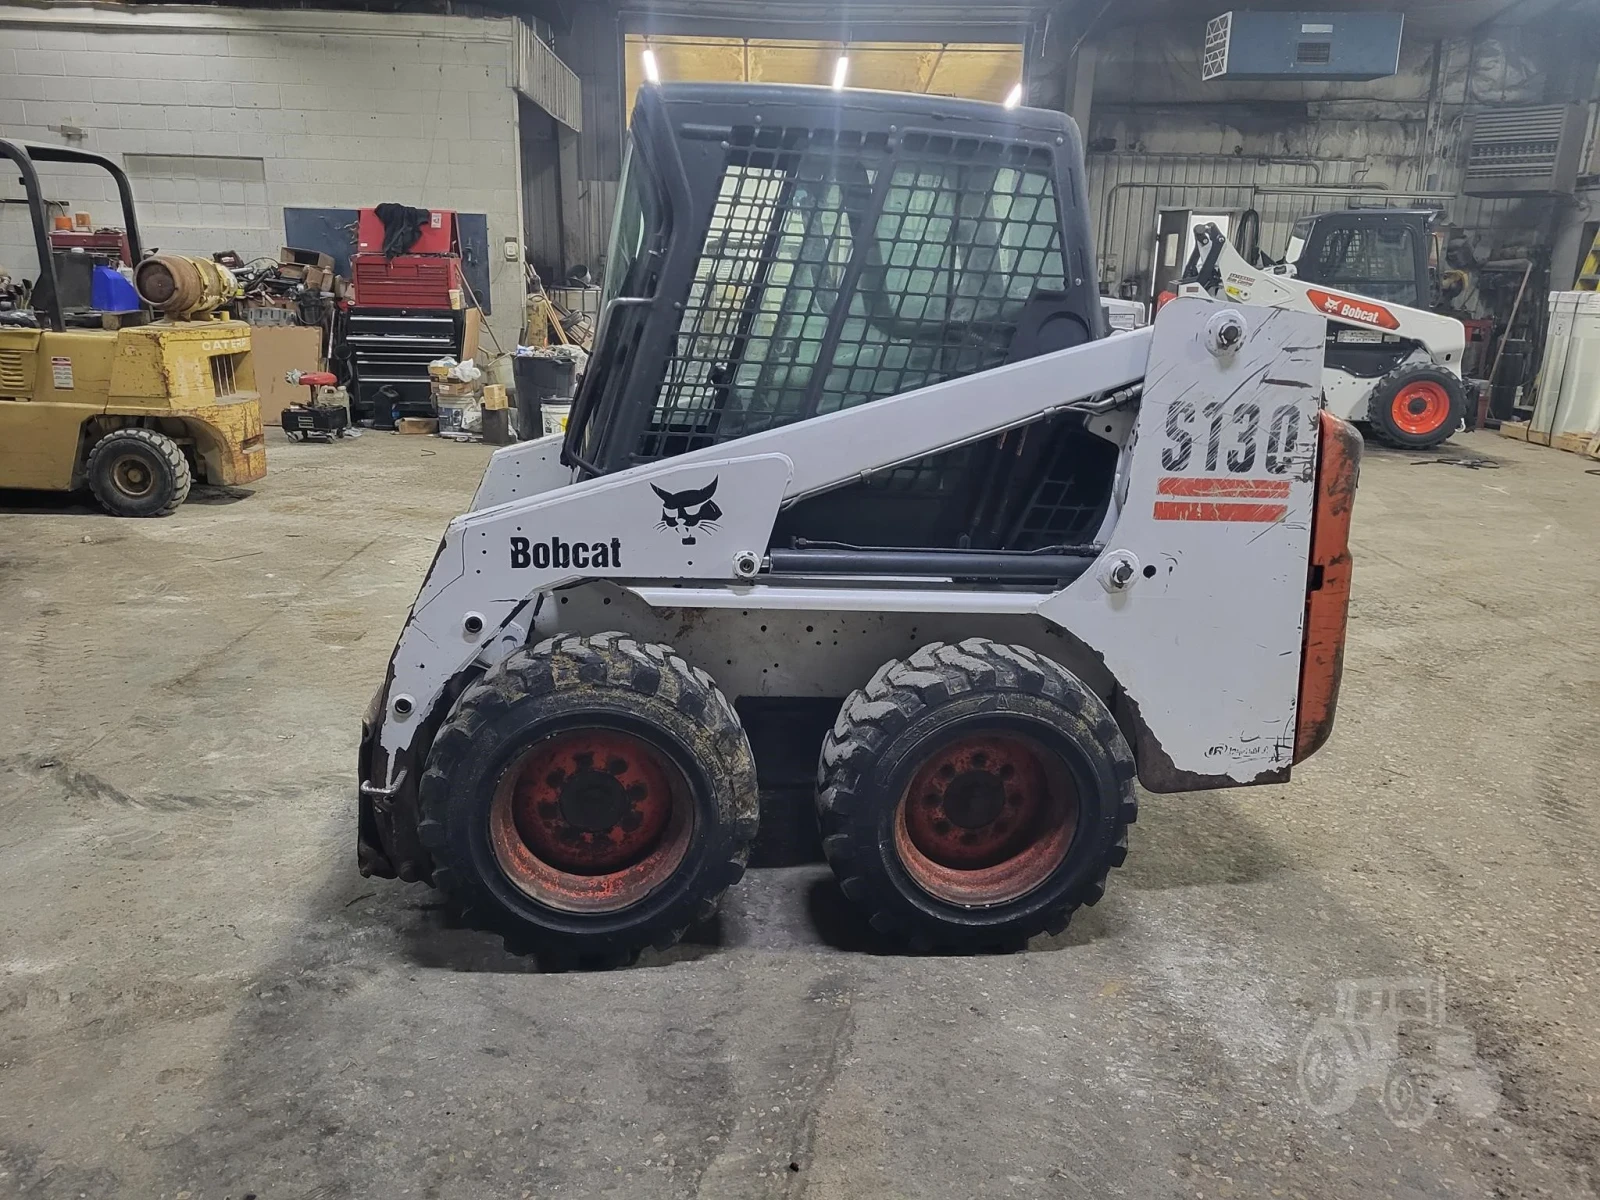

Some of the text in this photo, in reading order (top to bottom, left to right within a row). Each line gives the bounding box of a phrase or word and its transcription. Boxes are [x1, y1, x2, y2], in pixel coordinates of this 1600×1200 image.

[1341, 303, 1380, 324] Bobcat
[1161, 400, 1300, 475] S130
[510, 536, 622, 569] Bobcat
